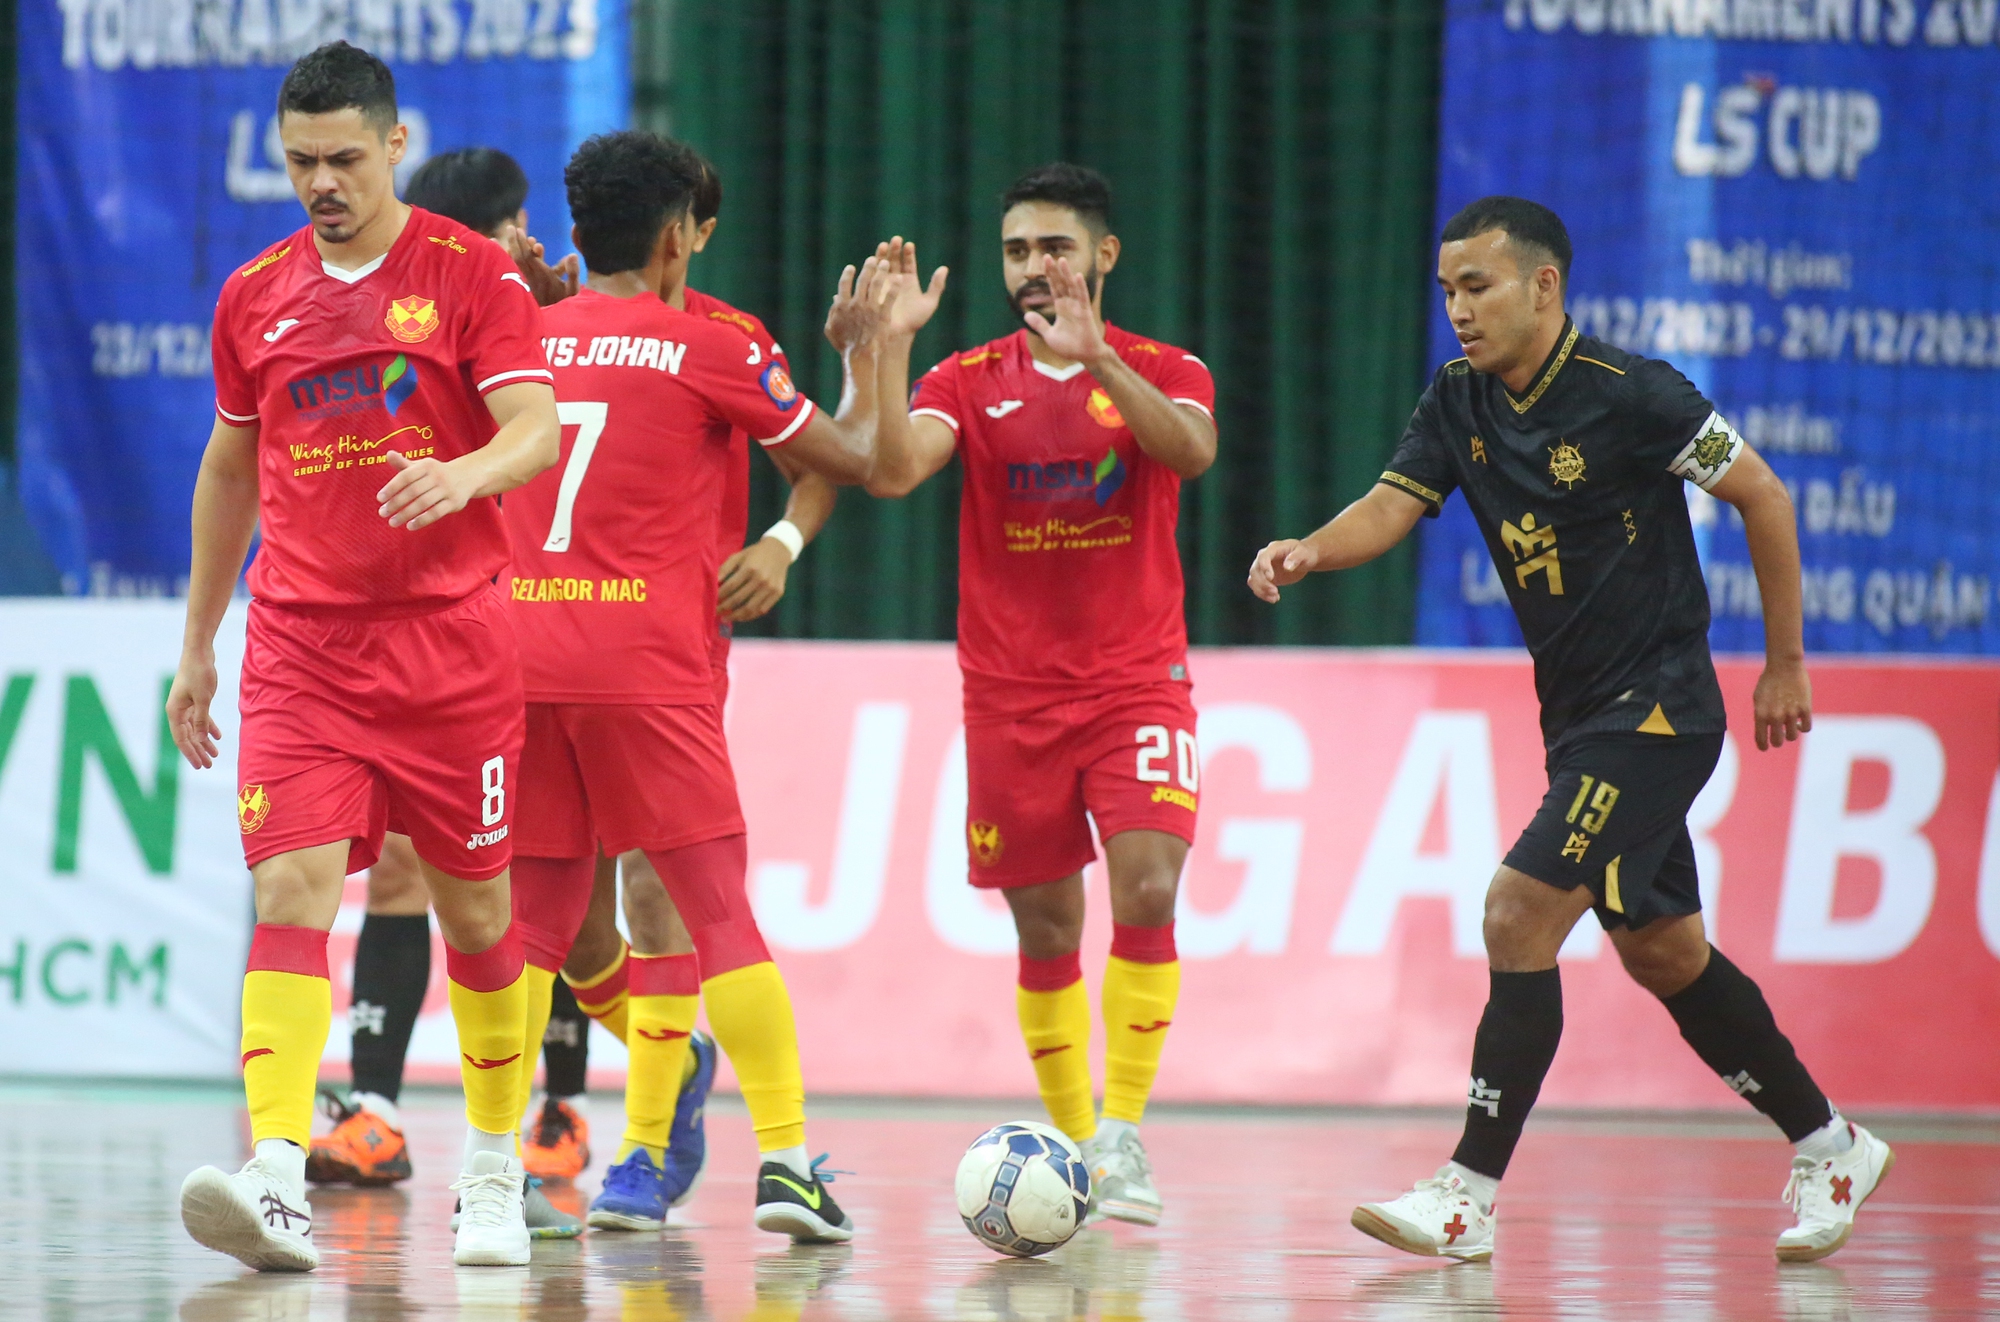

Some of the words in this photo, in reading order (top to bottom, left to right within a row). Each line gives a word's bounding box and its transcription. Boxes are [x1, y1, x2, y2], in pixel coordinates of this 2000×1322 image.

[1767, 87, 1882, 181] CUP
[576, 335, 687, 376] JOHAN
[288, 364, 381, 410] msu
[289, 443, 334, 463] Wing
[293, 463, 332, 477] GROUP
[336, 459, 354, 470] OF
[358, 446, 435, 466] COMNIES
[1006, 461, 1093, 490] msu
[542, 401, 609, 552] 7
[511, 577, 594, 602] SELANGOR
[600, 578, 647, 602] MAC
[1135, 724, 1199, 793] 20
[481, 754, 505, 827] 8
[1565, 773, 1620, 834] 19
